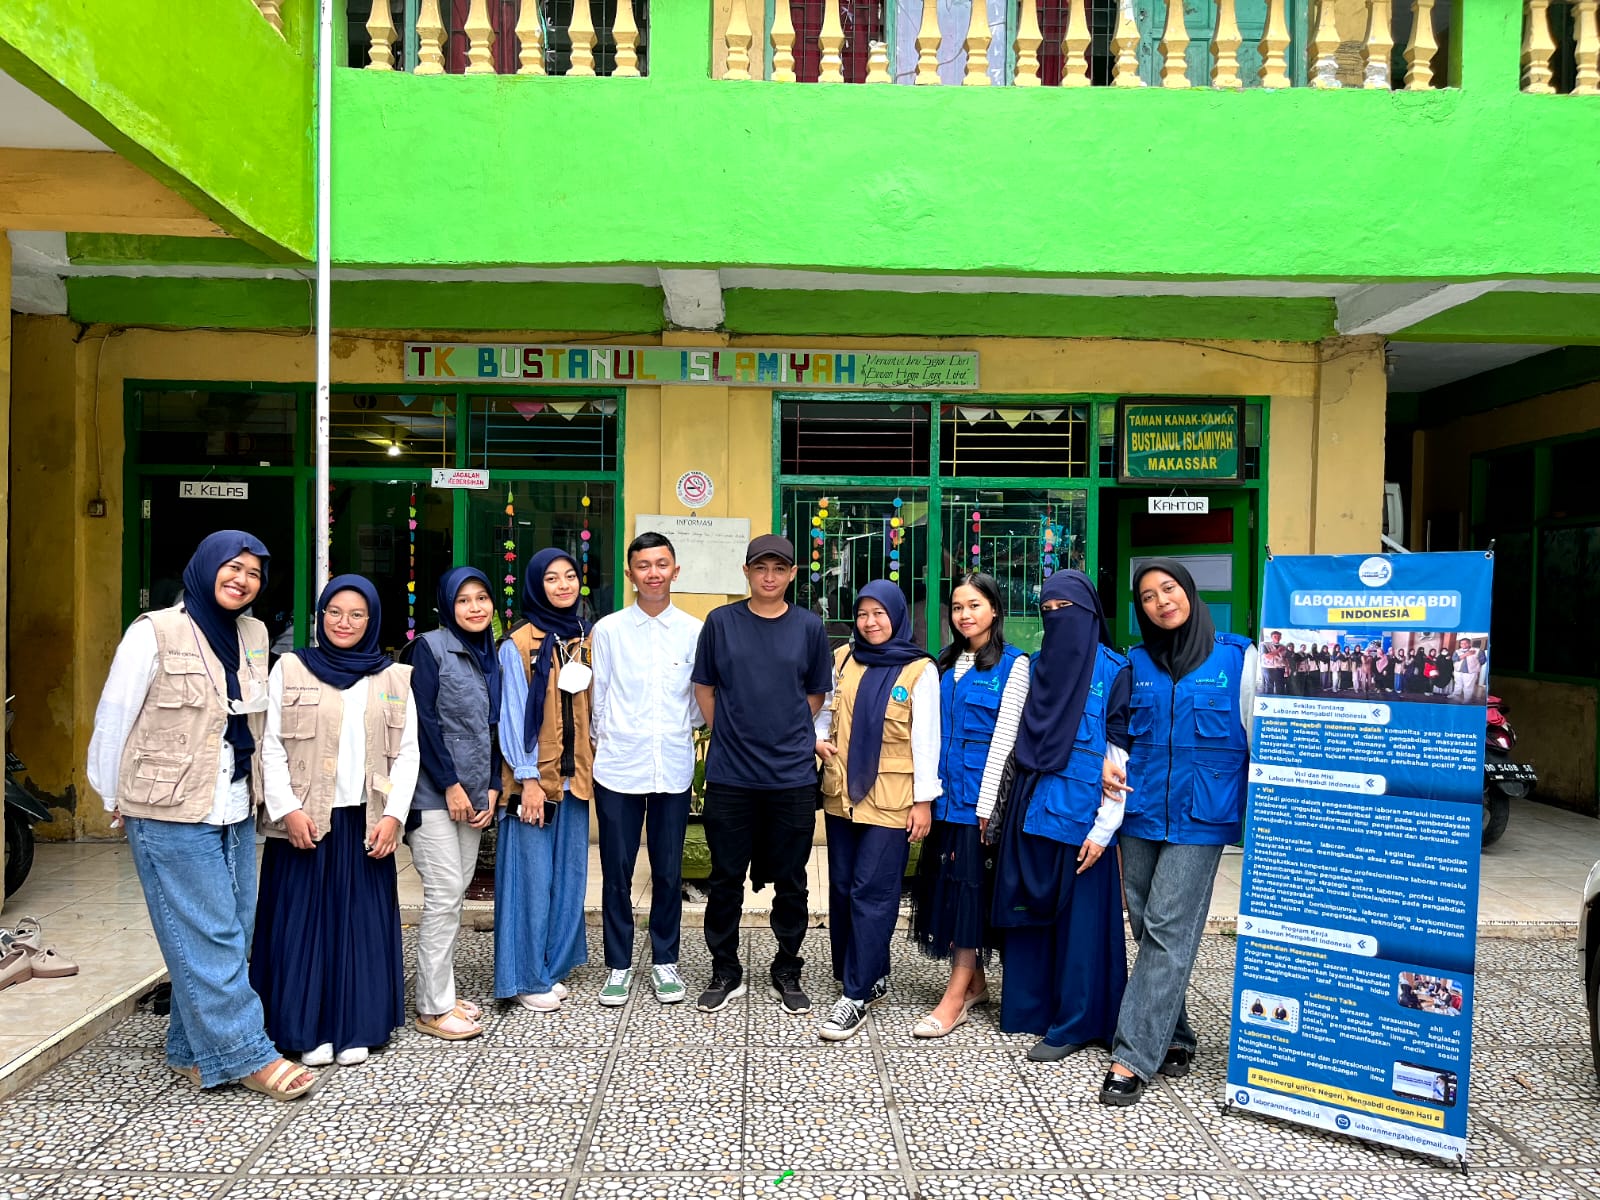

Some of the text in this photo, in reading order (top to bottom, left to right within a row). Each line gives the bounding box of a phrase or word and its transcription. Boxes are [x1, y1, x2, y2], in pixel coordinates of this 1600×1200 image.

[411, 347, 855, 383] TK BUSTANUL ISLAMIYAH
[1129, 414, 1234, 426] TAMAN KANAK-KANAK
[1131, 431, 1233, 451] BUSTANUL ISLAMIYAH
[1148, 457, 1217, 470] MAKASSAR
[184, 483, 243, 497] R. KELAS
[1153, 499, 1204, 511] KANTOR
[676, 519, 713, 527] INFORMASI
[1294, 594, 1457, 607] LABORAN MENGABDI
[1341, 608, 1410, 619] INDONESIA
[1274, 707, 1366, 719] Laboran Mengabdi Indonesia
[1324, 729, 1358, 740] khususnya
[1363, 732, 1384, 740] dalam
[1436, 739, 1477, 747] masyarakat
[1385, 726, 1477, 739] komunitas yang bergerak
[1324, 745, 1384, 756] program-program
[1423, 752, 1460, 761] kesehatan
[1393, 742, 1416, 750] adalah
[1299, 749, 1476, 772] dengan perubahan positif yang
[1296, 777, 1327, 786] Mengabdi
[1328, 780, 1360, 788] Indonesia
[1375, 805, 1400, 814] laboran
[1403, 809, 1428, 817] melalui
[1430, 811, 1455, 820] inovasi
[1457, 814, 1470, 822] dan
[1337, 825, 1364, 833] manusia
[1366, 828, 1382, 837] yang
[1420, 834, 1459, 844] berkualitas
[1420, 826, 1447, 835] laboran
[1451, 829, 1470, 838] demi
[1255, 841, 1291, 851] masyarakat
[1408, 860, 1435, 869] kualitas
[1439, 864, 1468, 873] layanan
[1320, 840, 1468, 864] laboran dalam kegiatan pengabdian
[1354, 869, 1408, 881] profesionalisme
[1411, 875, 1438, 885] laboran
[1440, 881, 1467, 889] melalui
[1376, 887, 1405, 898] laboran,
[1409, 893, 1434, 901] profesi
[1422, 903, 1466, 913] pengabdian
[1362, 908, 1388, 918] laboran
[1393, 914, 1411, 923] yang
[1258, 927, 1352, 948] Laboran Mengabdi Indonesia
[1281, 924, 1328, 938] Program Kerja
[1410, 923, 1424, 931] dan
[1427, 927, 1464, 938] pelayanan
[1295, 956, 1319, 967] dengan
[1352, 968, 1390, 980] masyarakat
[1329, 970, 1354, 981] layanan
[1378, 1016, 1420, 1028] narasumber
[1403, 1045, 1425, 1054] media
[1412, 1039, 1459, 1052] pengetahuan
[1278, 1044, 1316, 1058] kompetensi
[1318, 1053, 1331, 1061] dan
[1332, 1058, 1385, 1073] profesionalisme
[1258, 1074, 1432, 1118] Bersinergi untuk Negeri, Mengabdi dengan Hati
